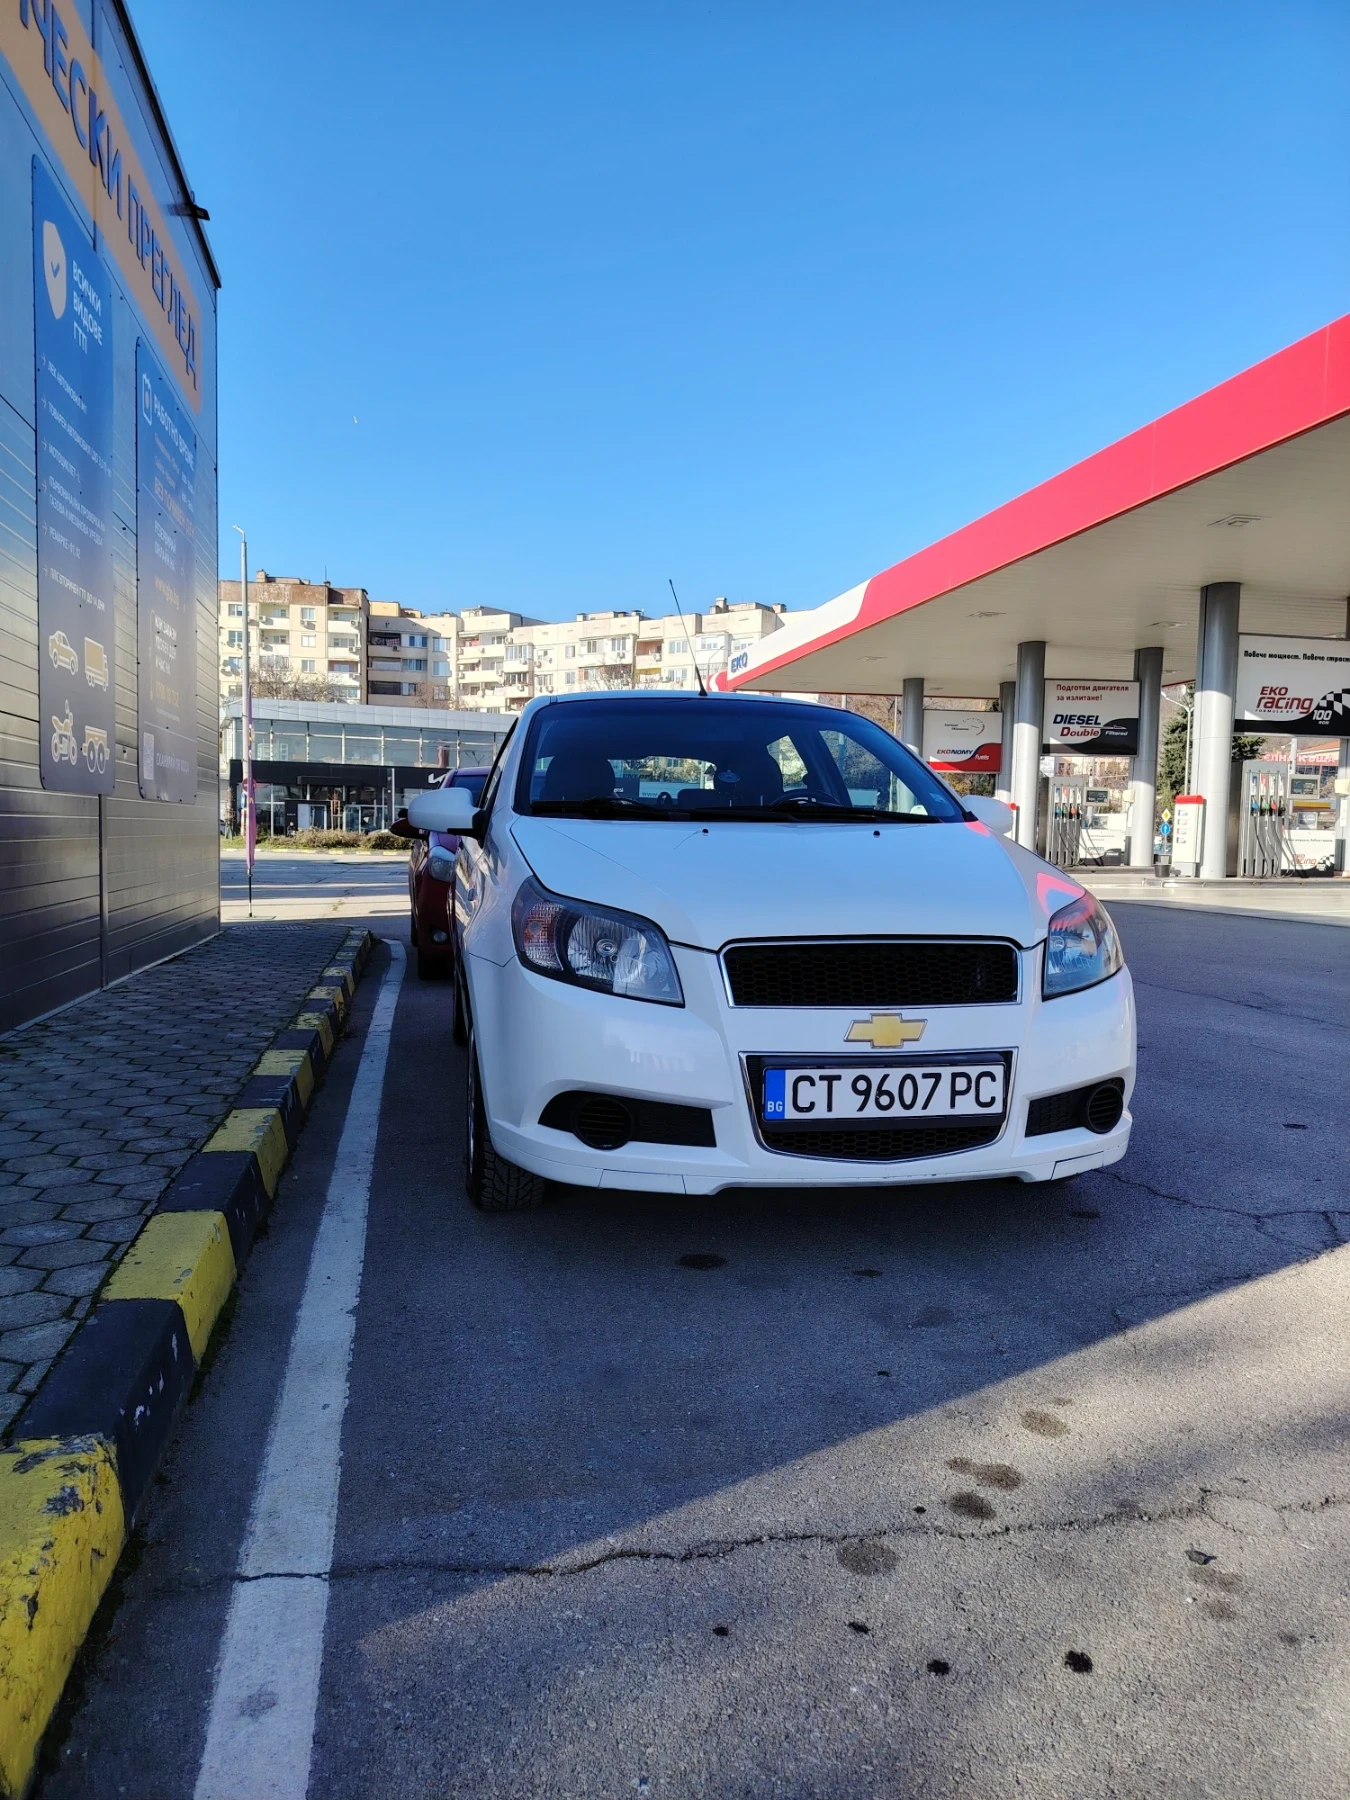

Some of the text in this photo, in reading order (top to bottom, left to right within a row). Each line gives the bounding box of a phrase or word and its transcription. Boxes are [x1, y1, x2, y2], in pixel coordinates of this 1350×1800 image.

[72, 259, 102, 317] ВСИЧКИ
[128, 174, 197, 391] ПРЕГЛЕД
[73, 290, 103, 346] ВИДОВЕ
[73, 320, 88, 354] ГТП
[153, 393, 178, 448] РАБОТНО
[178, 433, 194, 472] ВРЕМЕ
[731, 652, 748, 673] EKO
[1244, 650, 1267, 659] Повече
[1268, 652, 1301, 660] мощност.
[1303, 653, 1325, 661] Повече
[1056, 684, 1090, 692] Подготви
[1260, 686, 1288, 696] EKO
[1256, 696, 1314, 714] racing
[1053, 714, 1101, 725] DIESEL
[1313, 709, 1333, 721] 100
[1060, 726, 1100, 737] Double
[791, 1070, 997, 1113] CT 9607 PC
[767, 1101, 783, 1112] BG
